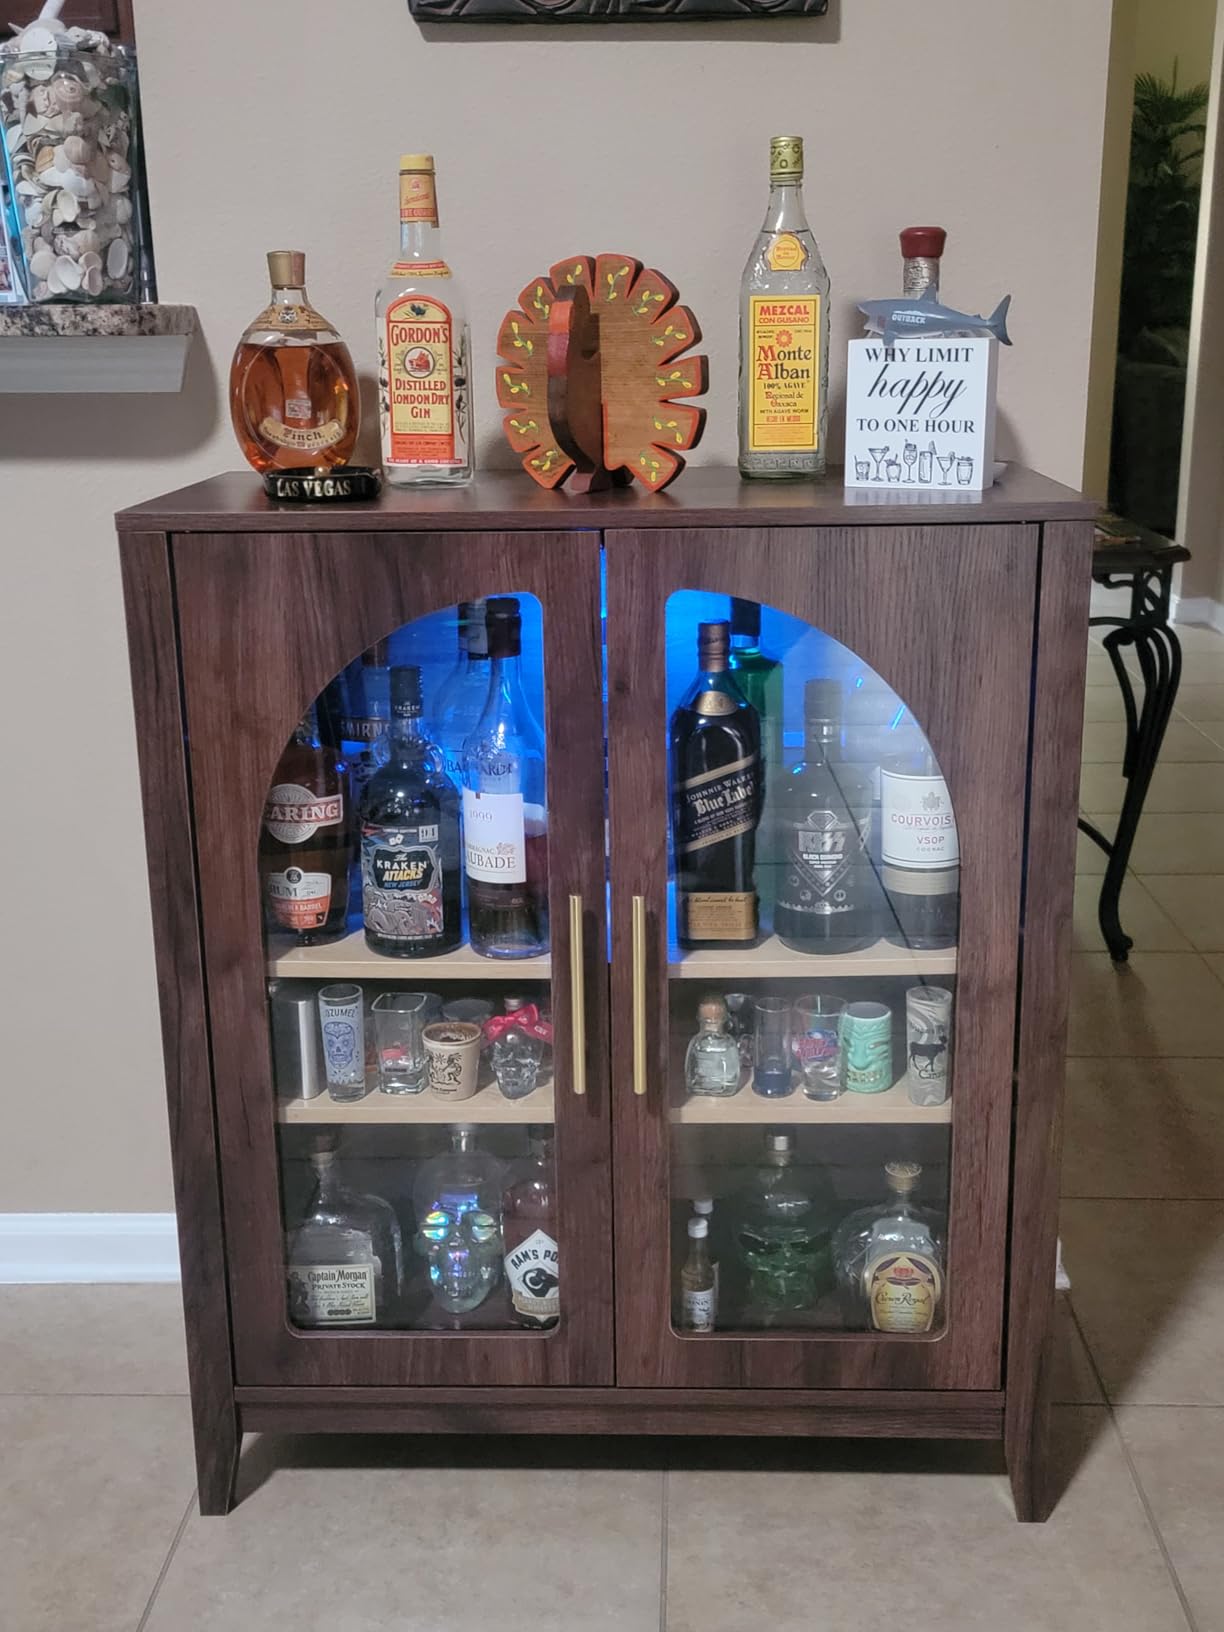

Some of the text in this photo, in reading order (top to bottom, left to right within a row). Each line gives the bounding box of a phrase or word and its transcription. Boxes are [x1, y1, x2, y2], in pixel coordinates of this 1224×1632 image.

[759, 305, 809, 316] MEZCAL
[390, 324, 449, 346] GORDON'S
[756, 344, 812, 362] Monte
[865, 347, 974, 363] WHY LIMIT
[757, 362, 811, 381] Alban
[395, 378, 447, 391] DISTILLED
[867, 363, 968, 420] happy
[393, 392, 450, 405] LONDON DRY
[410, 406, 431, 419] GIN
[856, 418, 975, 433] TO ONE HOUR
[277, 479, 351, 497] LAS VEGAS
[686, 784, 722, 803] JOHNNIE
[268, 803, 338, 822] ARING
[692, 796, 726, 817] Blue
[470, 809, 493, 822] 1999
[917, 835, 945, 845] VSOP
[376, 859, 427, 871] KRAKEN
[382, 868, 424, 882] ATTACKS
[325, 1008, 356, 1018] OZUMEL
[511, 1248, 558, 1270] RAM'S PO
[307, 1270, 368, 1283] Captain Morgan
